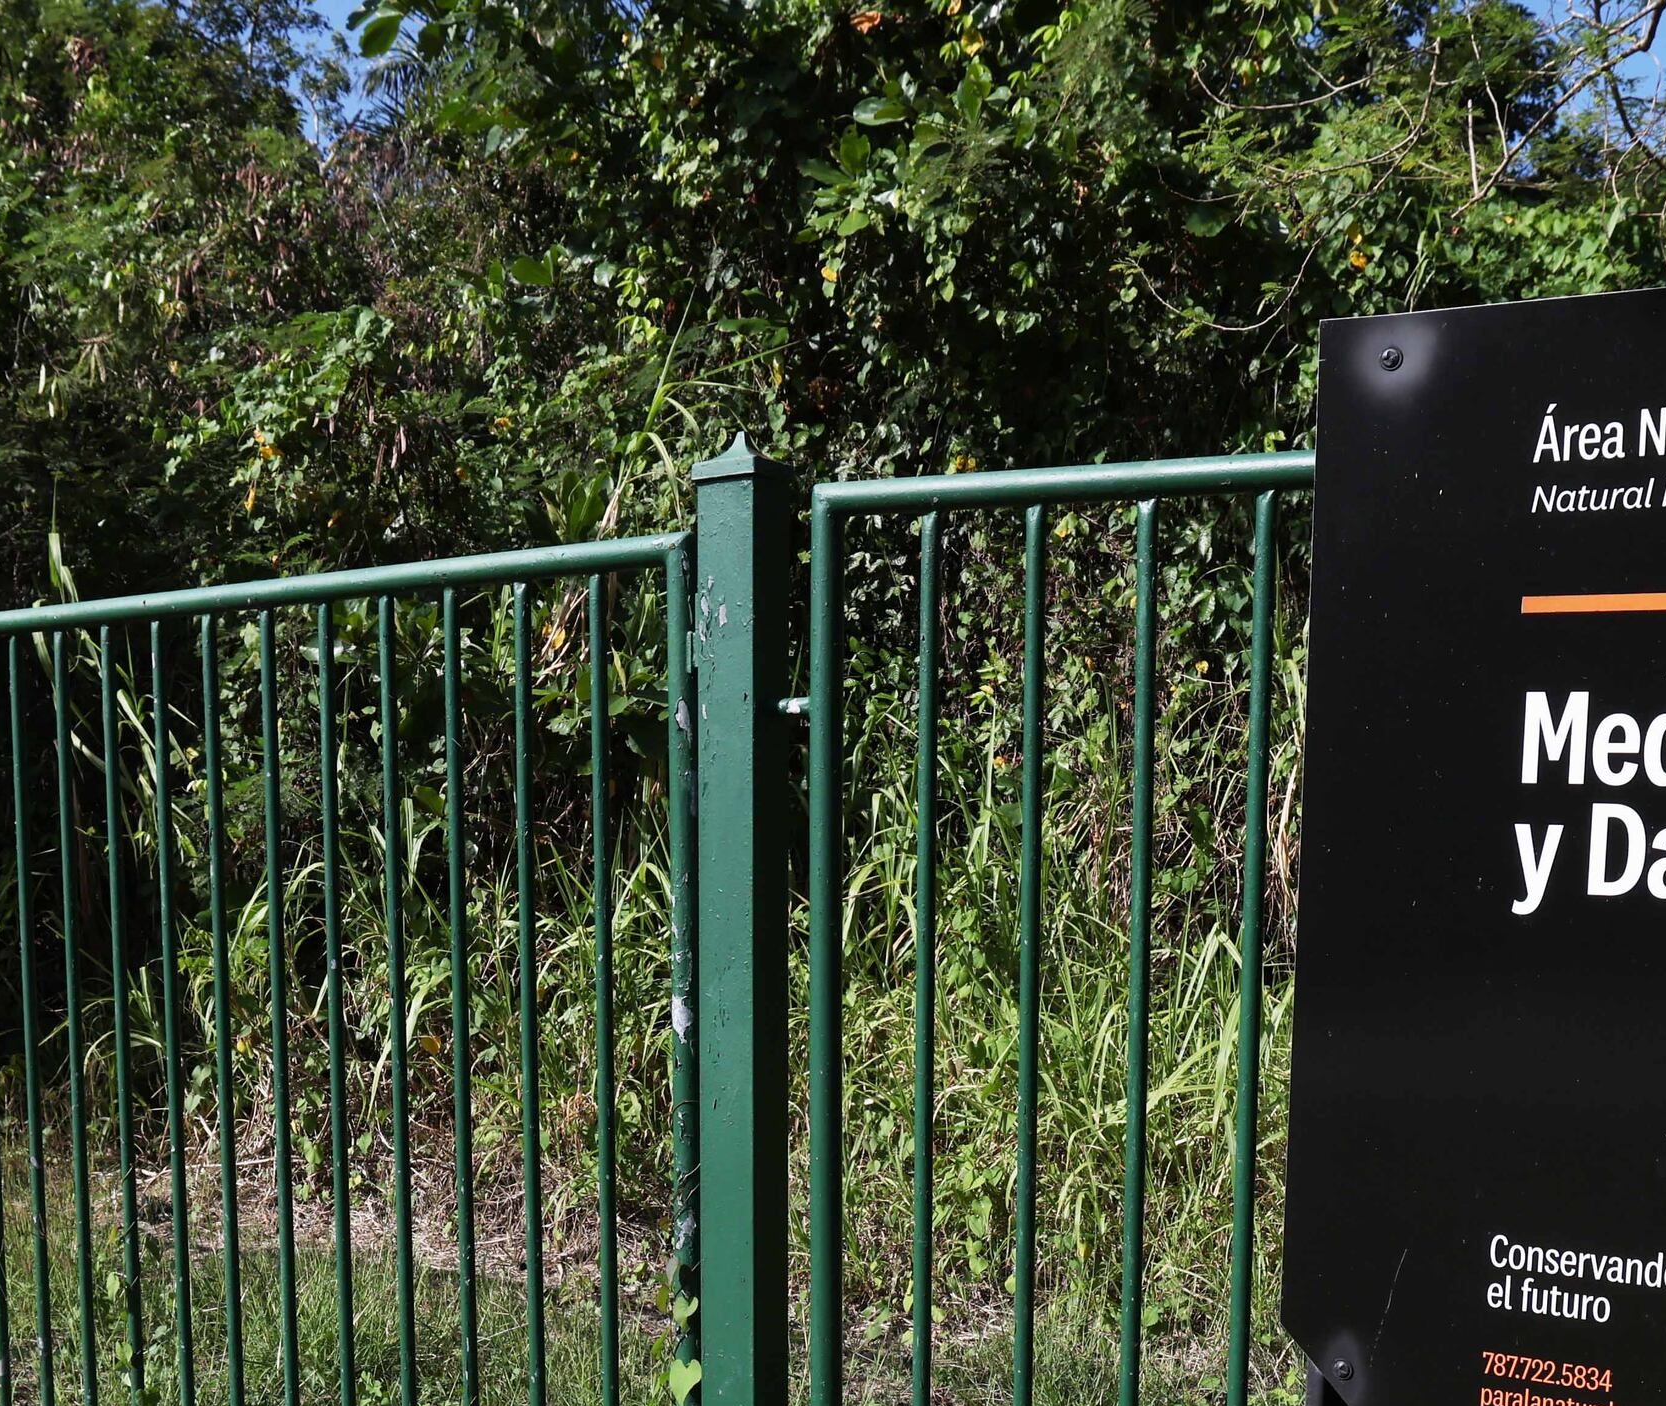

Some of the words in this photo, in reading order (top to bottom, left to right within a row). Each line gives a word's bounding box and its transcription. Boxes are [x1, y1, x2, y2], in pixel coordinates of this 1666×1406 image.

[1532, 403, 1626, 464] Área
[1531, 477, 1655, 514] Natural
[1511, 823, 1565, 916] y
[1486, 1274, 1513, 1311] el
[1520, 1277, 1611, 1323] futuro
[1482, 1351, 1613, 1393] 787.722.5834
